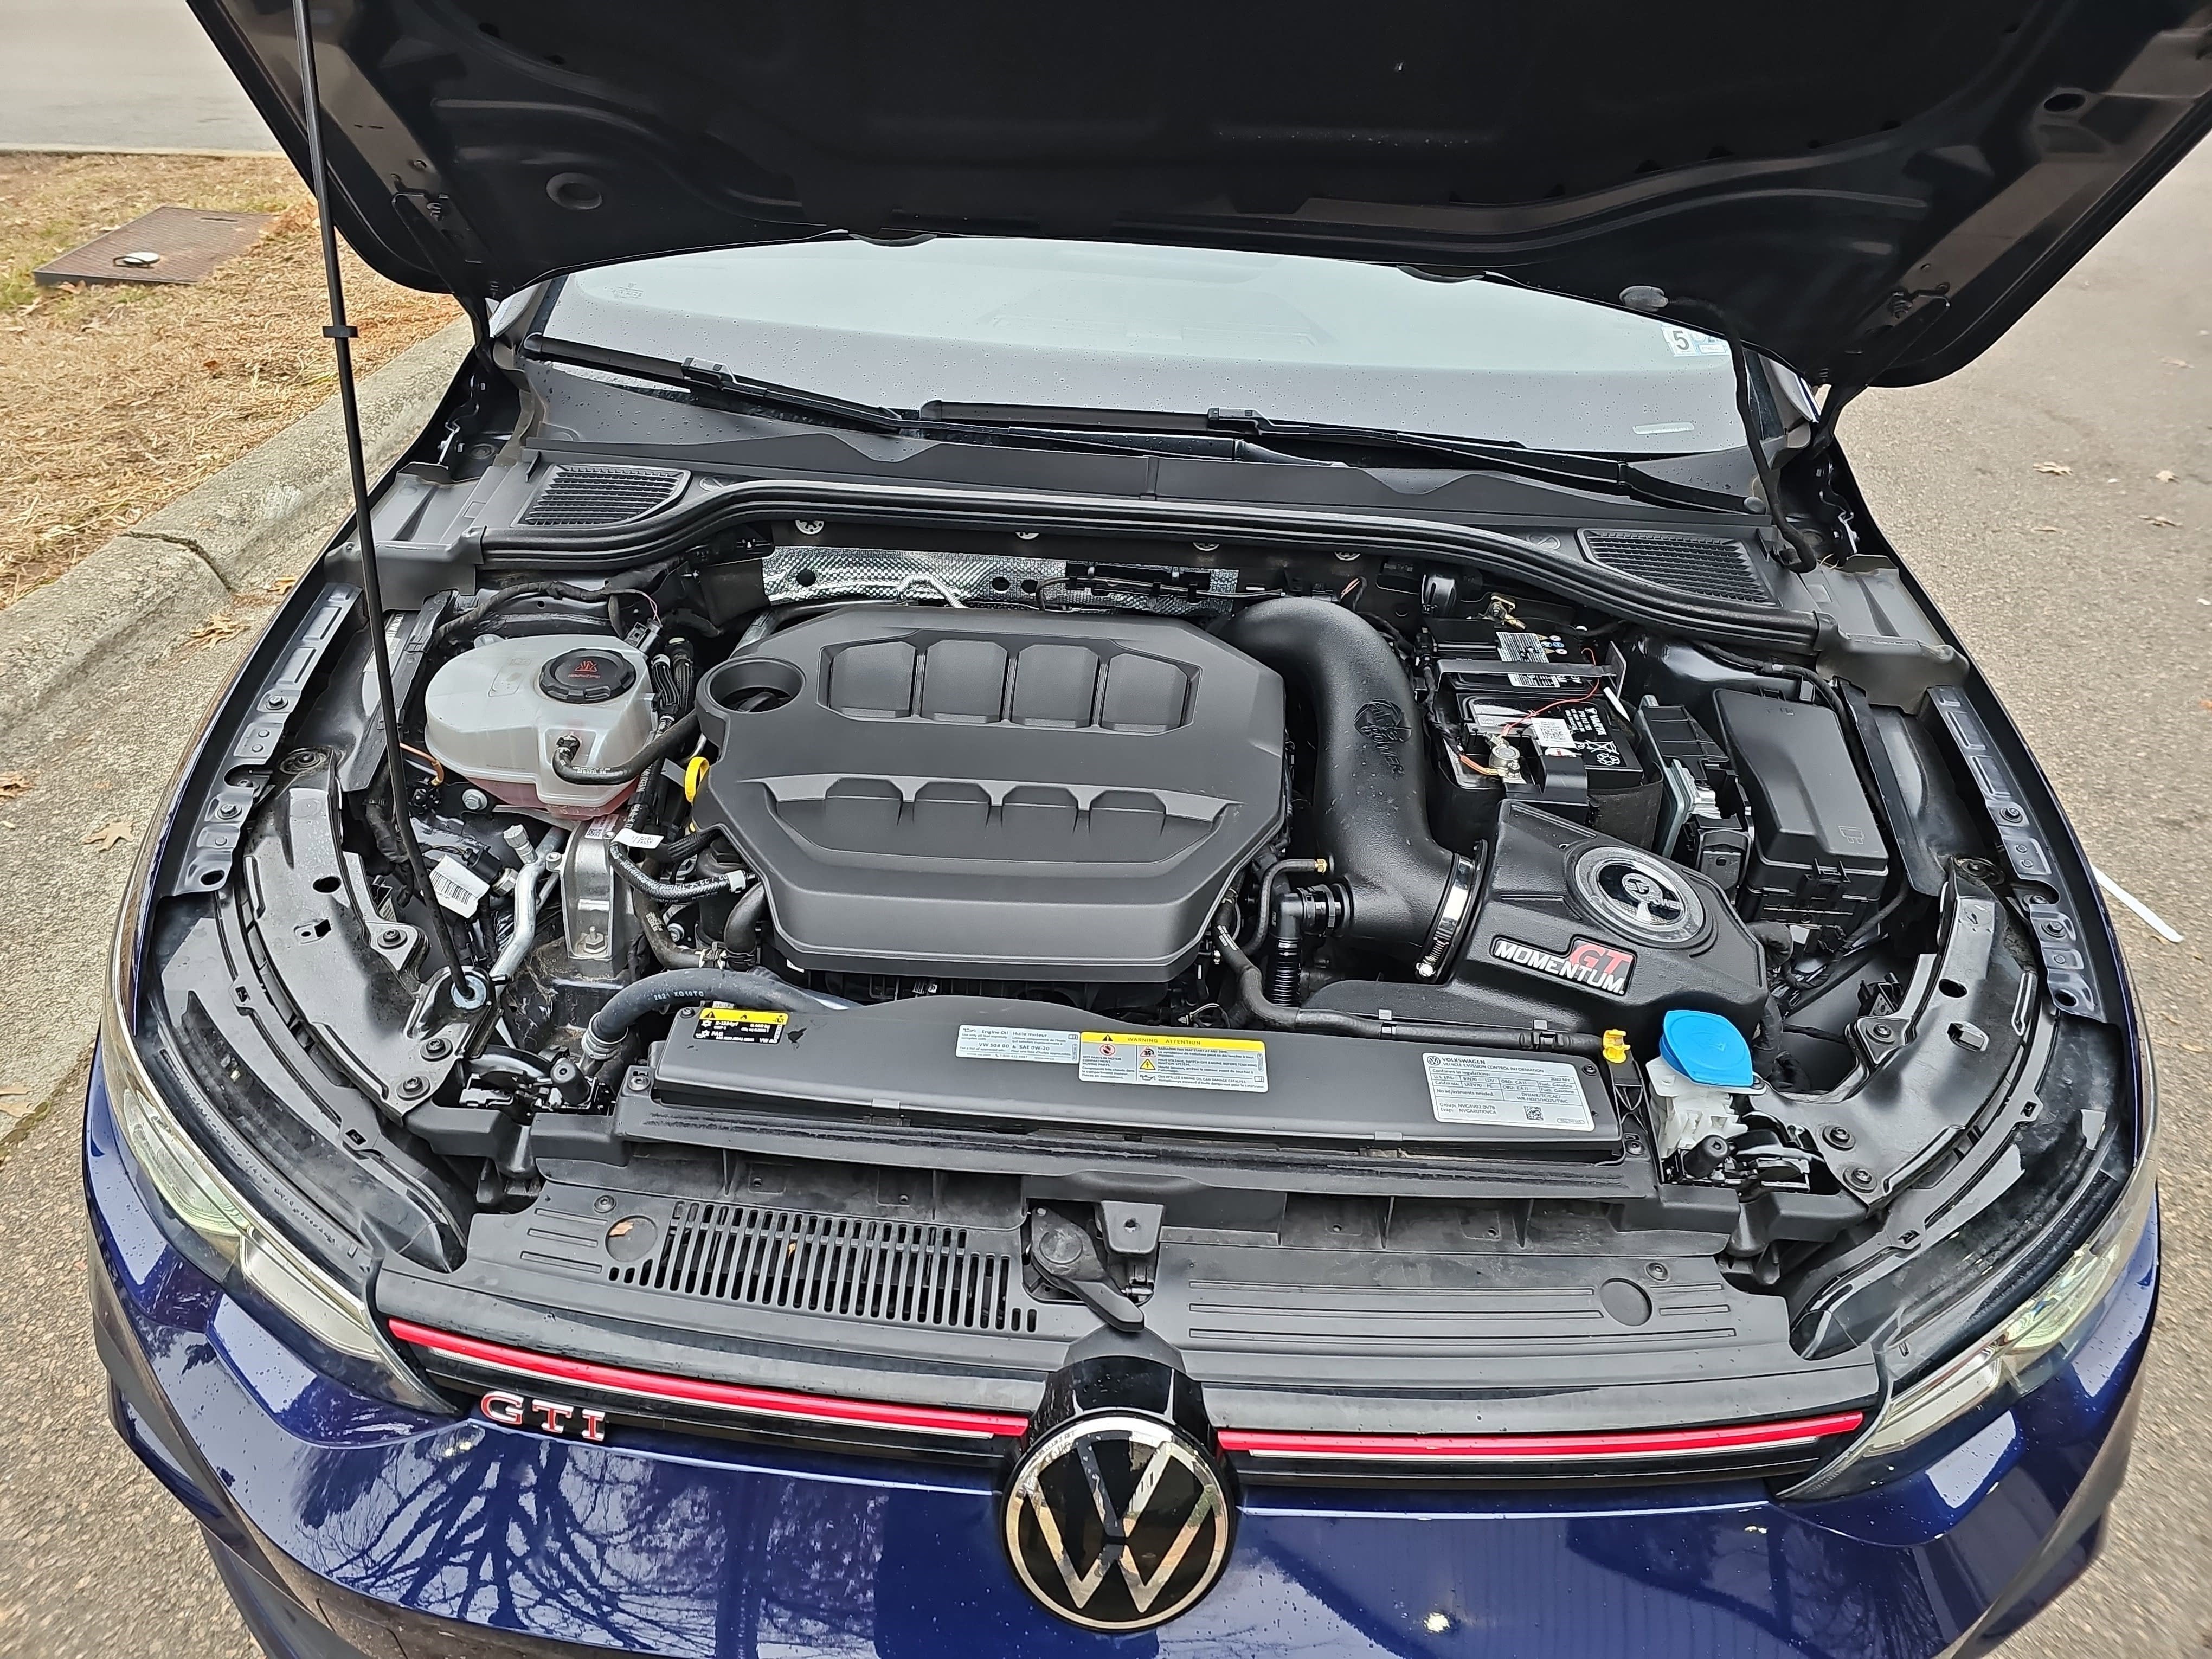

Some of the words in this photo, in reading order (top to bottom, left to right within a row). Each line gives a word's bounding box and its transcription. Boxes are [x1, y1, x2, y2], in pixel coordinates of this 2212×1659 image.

[1673, 330, 1689, 350] 5
[1590, 713, 1607, 736] VARTA
[1570, 943, 1634, 974] GT
[481, 1391, 605, 1441] GTI
